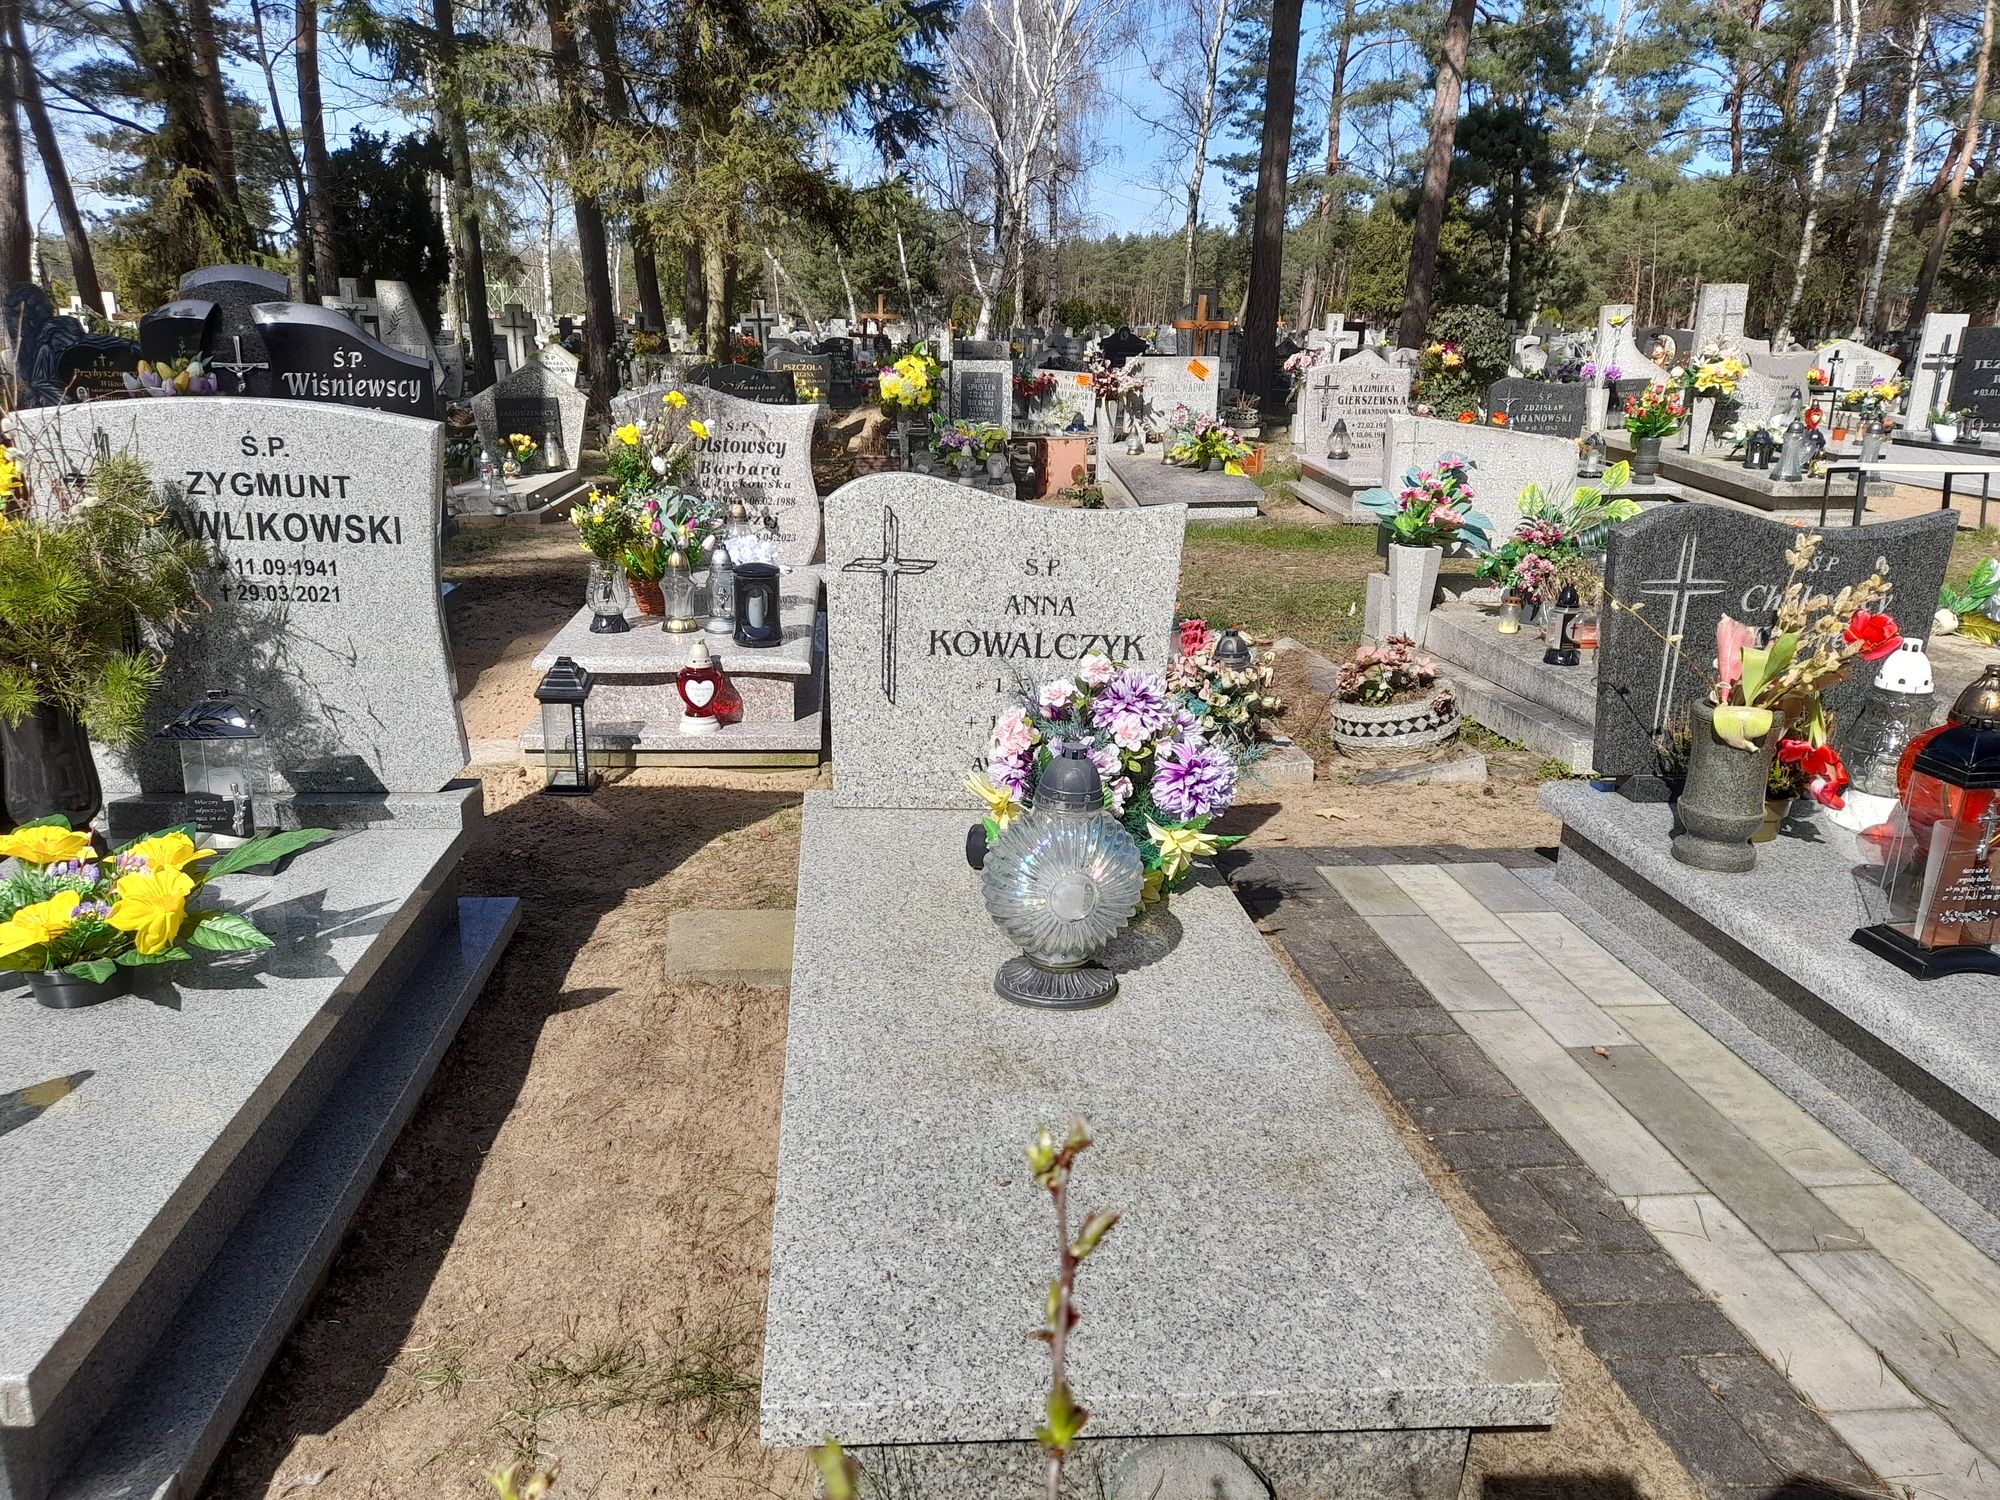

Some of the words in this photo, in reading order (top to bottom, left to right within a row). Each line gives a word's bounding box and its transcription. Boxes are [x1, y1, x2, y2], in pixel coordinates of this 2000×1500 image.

[333, 346, 367, 368] Ś.P.
[281, 371, 421, 404] Wiśniewscy
[1352, 384, 1396, 393] KAZIMIERA
[1337, 395, 1407, 405] GIERSZEWSKA
[1515, 413, 1572, 423] ARANOWSKI
[241, 429, 290, 458] Ś.P.
[700, 461, 781, 476] Barbara
[186, 471, 351, 499] ZYGMUNT
[167, 511, 402, 545] AWLIKOWSKI
[235, 558, 338, 577] 11.09.1941
[236, 584, 341, 603] 29.03.2021
[1004, 594, 1076, 617] ANNA
[929, 628, 1146, 661] KOWALCZYK
